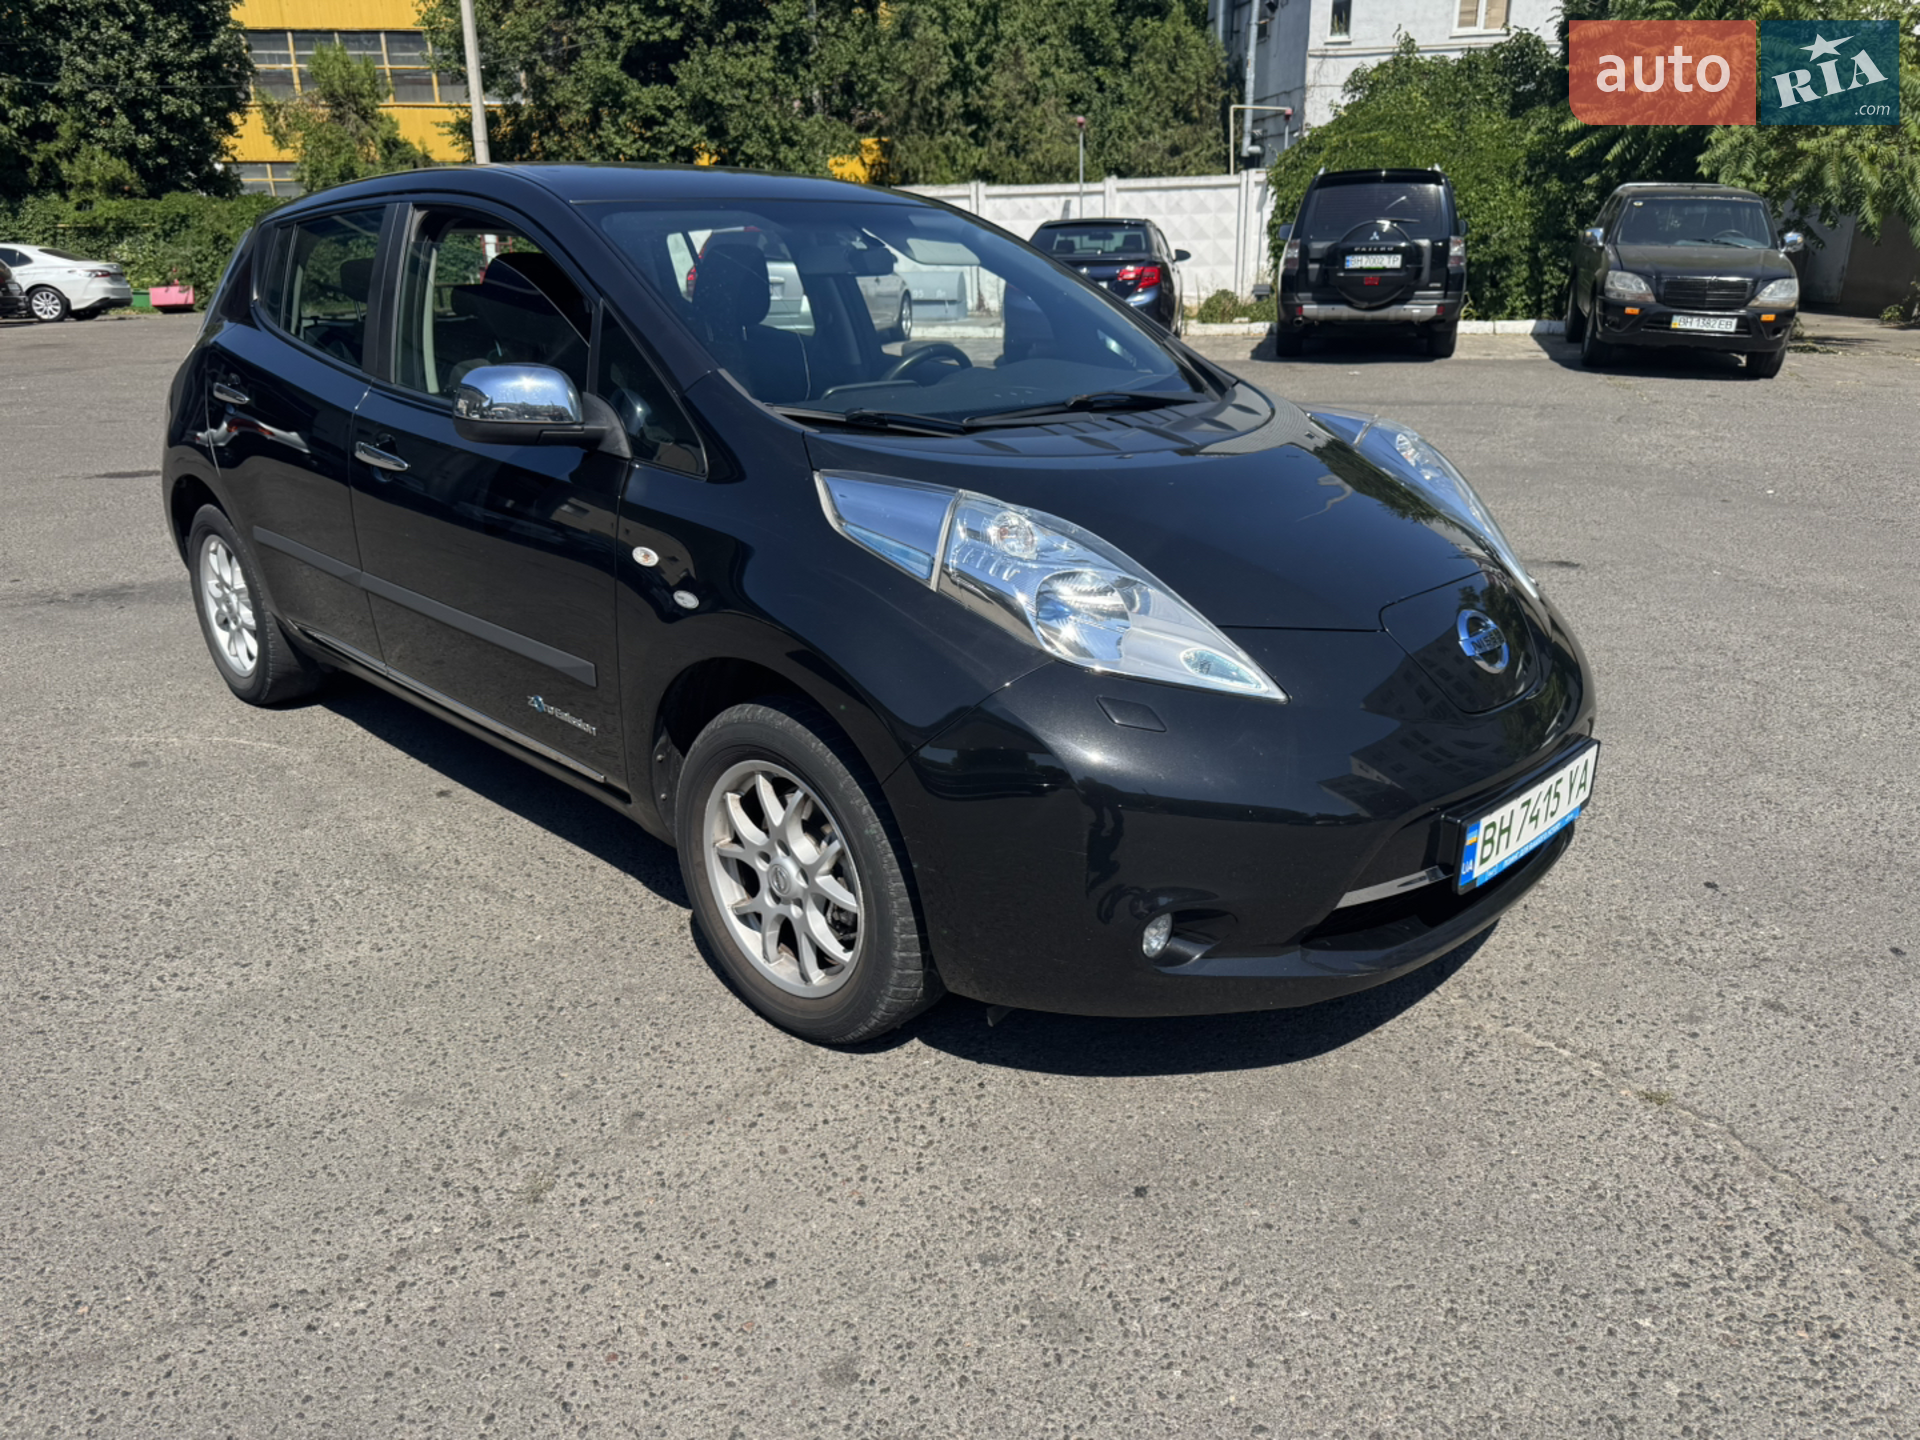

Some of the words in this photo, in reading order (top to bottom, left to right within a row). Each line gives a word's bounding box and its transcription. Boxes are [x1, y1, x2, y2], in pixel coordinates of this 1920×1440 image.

[1479, 808, 1515, 868] BH
[1516, 776, 1564, 843] 7415
[1567, 758, 1590, 806] YA
[1461, 859, 1474, 875] UA
